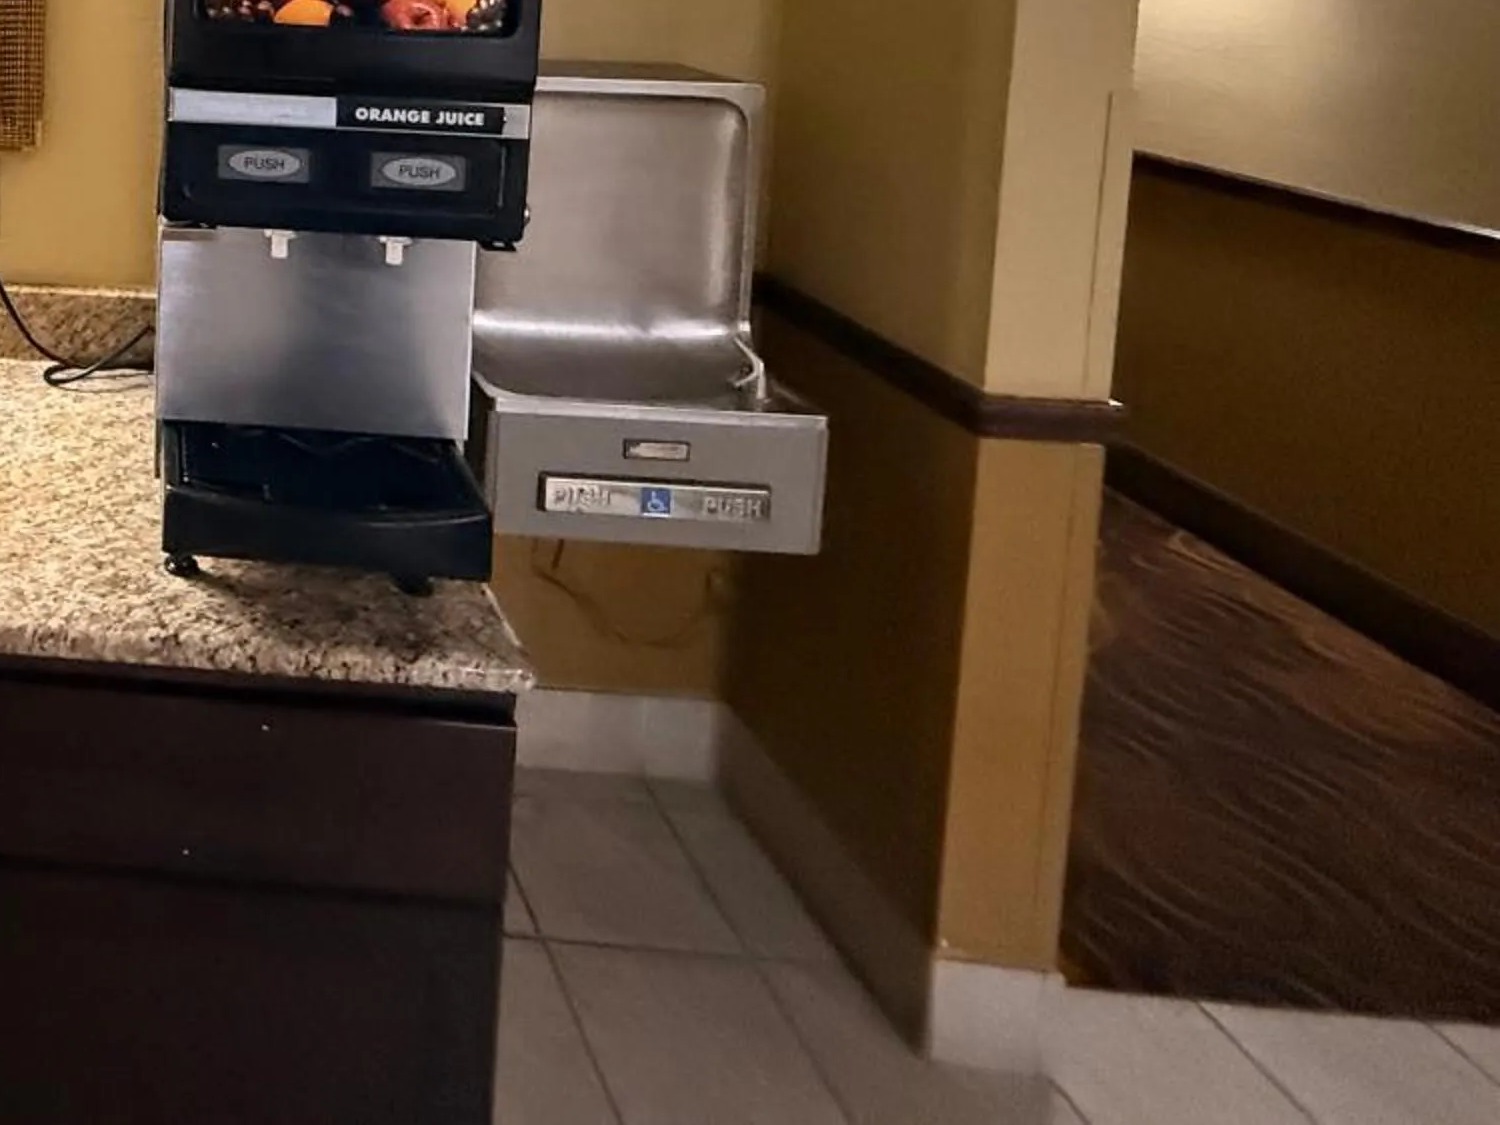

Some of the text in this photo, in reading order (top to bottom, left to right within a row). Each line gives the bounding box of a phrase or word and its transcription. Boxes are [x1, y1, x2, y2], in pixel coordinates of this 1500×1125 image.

[355, 106, 485, 126] ORANGE JUICE
[243, 156, 285, 171] PUSH
[399, 165, 441, 180] PUSH
[703, 495, 763, 518] PUSH
